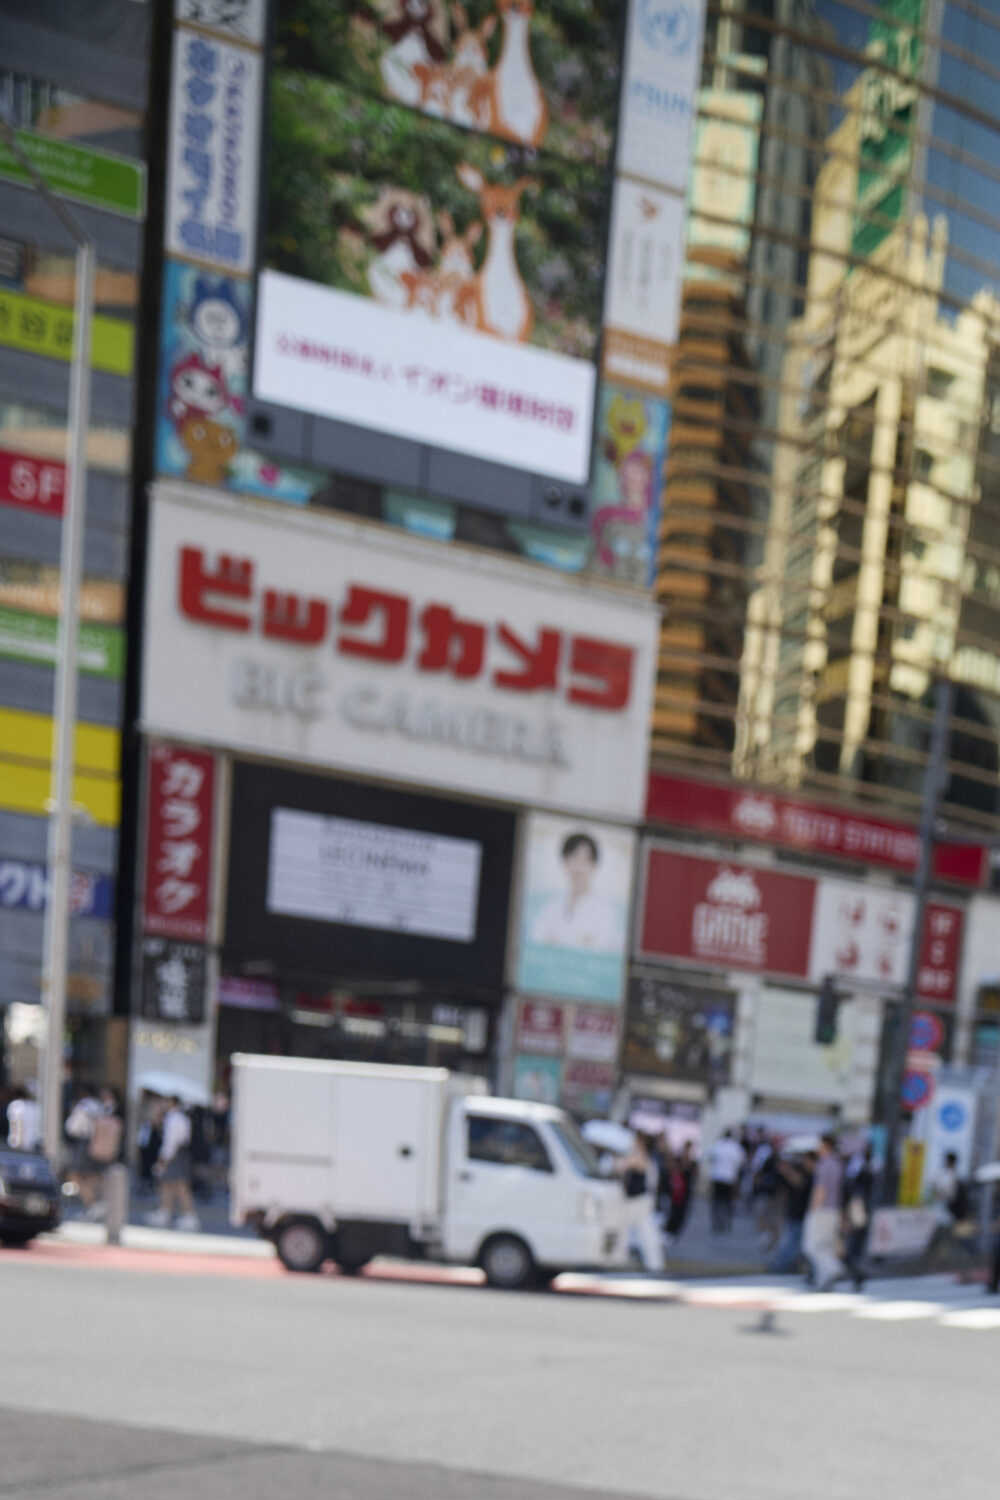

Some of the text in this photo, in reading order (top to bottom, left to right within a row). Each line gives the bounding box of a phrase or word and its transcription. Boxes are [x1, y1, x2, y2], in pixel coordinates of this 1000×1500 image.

[177, 544, 637, 714] ビックカメラ
[231, 656, 572, 771] BIG CAMERA
[154, 758, 205, 914] カラオケ
[692, 902, 769, 952] GAME
